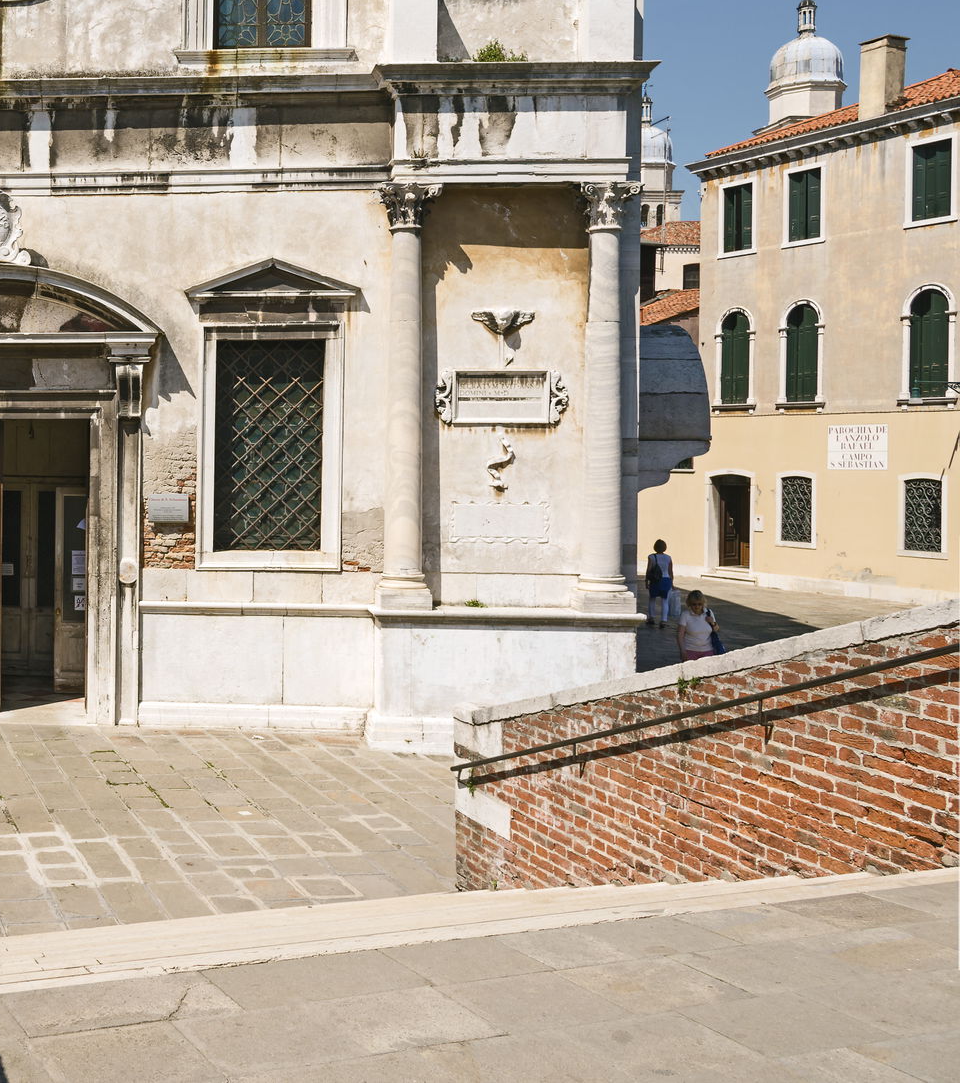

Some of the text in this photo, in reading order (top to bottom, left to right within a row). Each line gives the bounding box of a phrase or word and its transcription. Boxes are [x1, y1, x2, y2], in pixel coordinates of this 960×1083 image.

[828, 426, 872, 435] PAROCHIA
[840, 442, 873, 450] RAFAEL
[841, 453, 873, 461] CAMPO
[838, 460, 885, 469] SEBASTIAN
